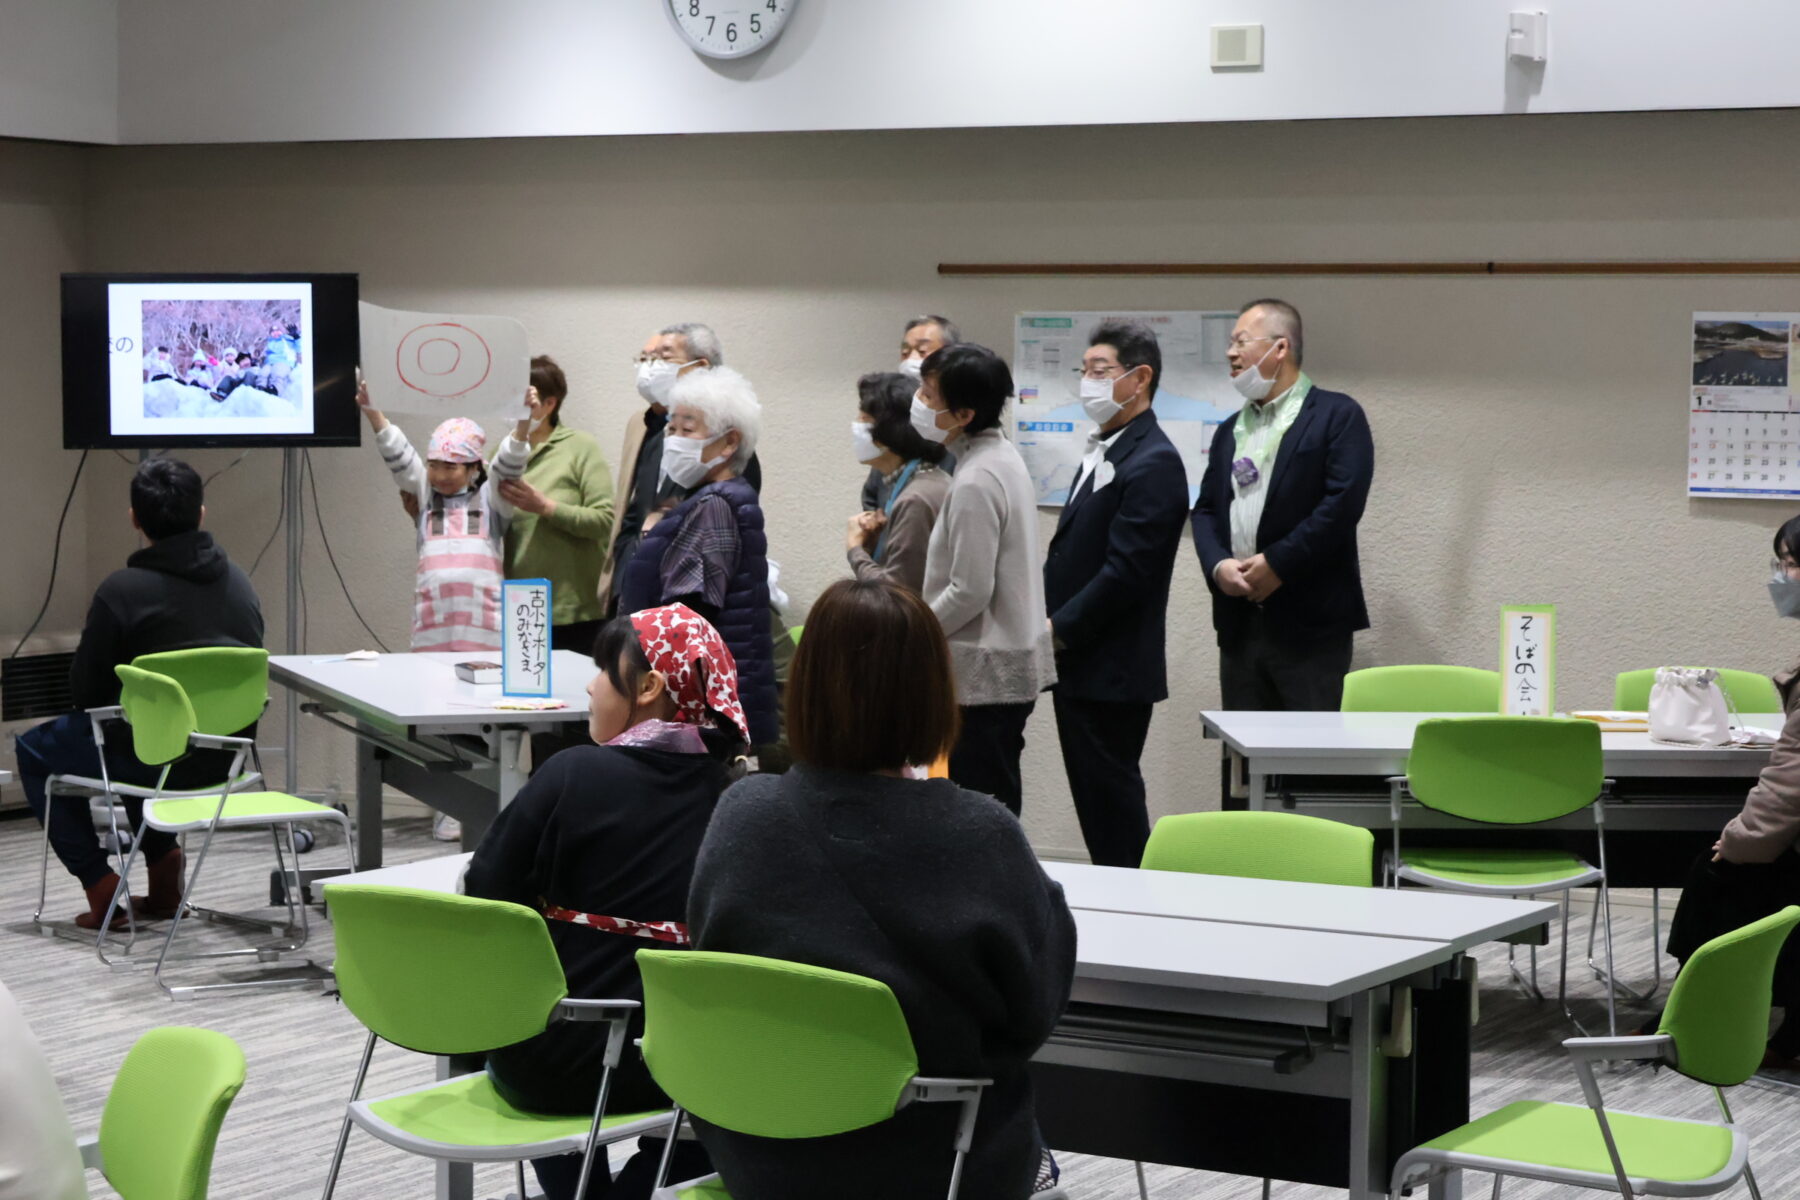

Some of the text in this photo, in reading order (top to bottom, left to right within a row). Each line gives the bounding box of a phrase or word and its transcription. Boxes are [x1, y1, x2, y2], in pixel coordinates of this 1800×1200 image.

[689, 0, 699, 16] 8
[766, 0, 776, 12] 4
[706, 16, 715, 35] 7
[726, 23, 737, 42] 6
[750, 14, 760, 33] 5
[110, 337, 134, 353] の
[1696, 396, 1702, 406] 1
[516, 604, 532, 672] のみなさま
[1514, 616, 1538, 716] そばの会
